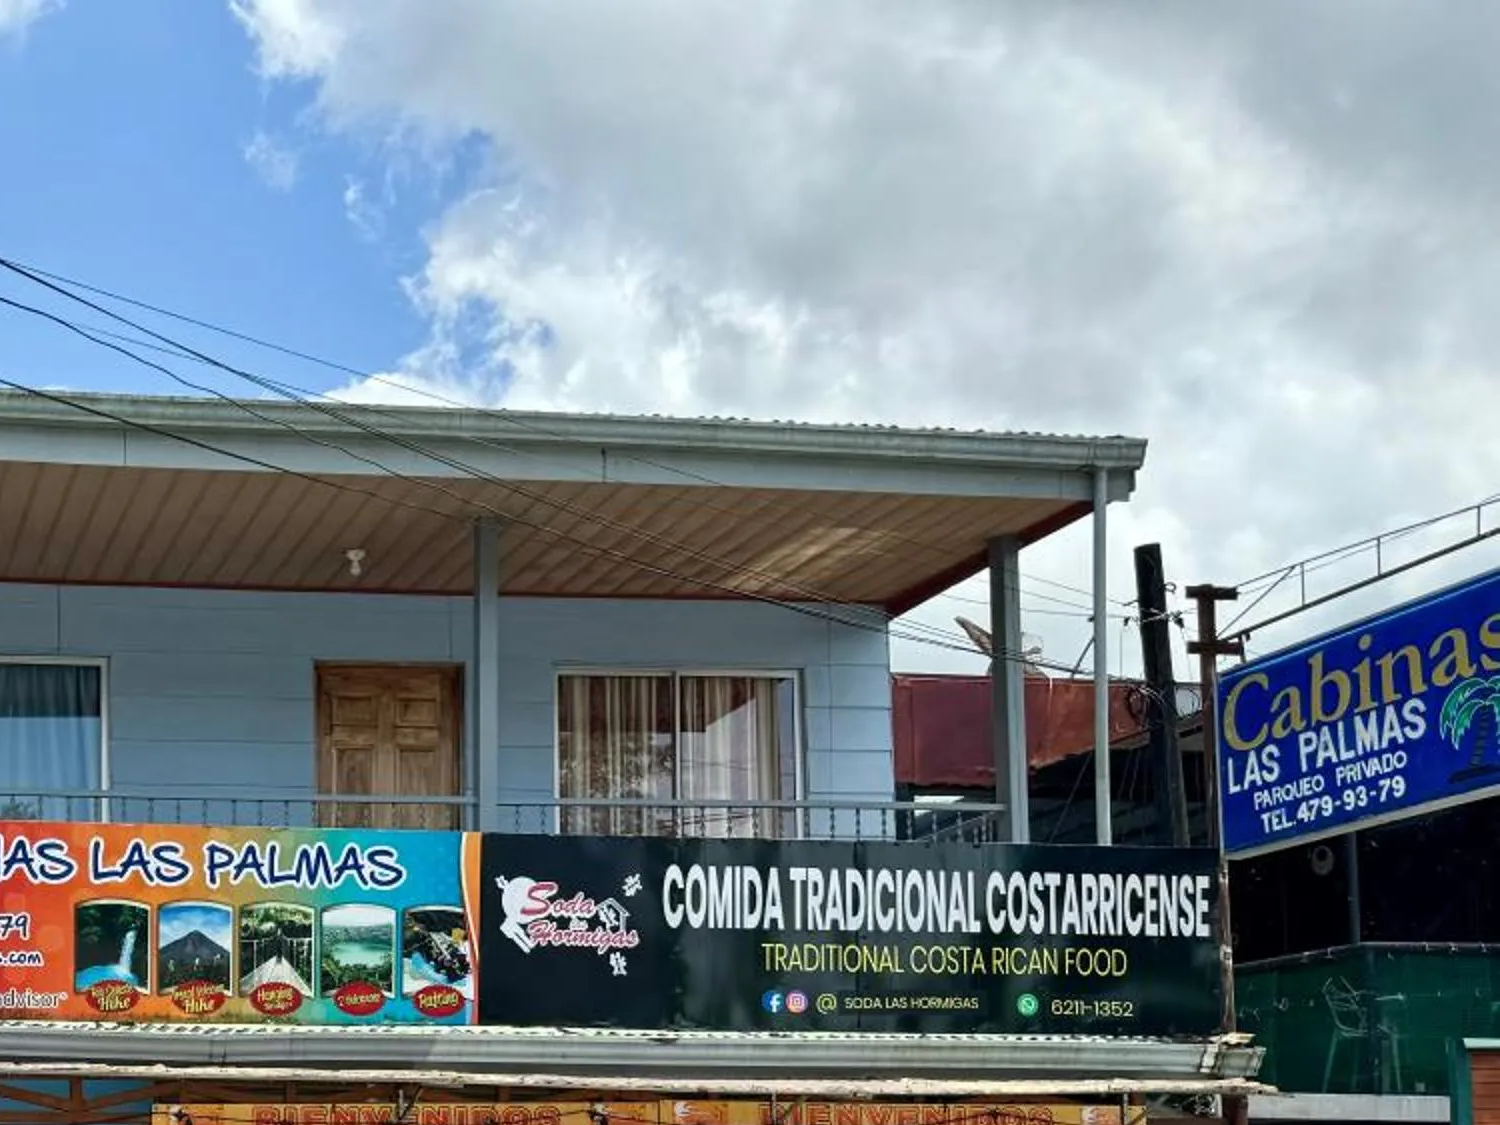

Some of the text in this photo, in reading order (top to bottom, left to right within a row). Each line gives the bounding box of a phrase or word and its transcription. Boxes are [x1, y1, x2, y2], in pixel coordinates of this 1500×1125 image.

[1228, 698, 1427, 795] LAS PALMAS
[1253, 750, 1407, 811] PARQUEO PRIVADO
[87, 838, 193, 887] LAS
[203, 841, 407, 891] PALMAS
[520, 881, 597, 917] Soda
[662, 863, 1211, 937] COMIDA TRADICIONAL COSTARRICENSE
[527, 920, 640, 955] Hormigas
[761, 942, 1128, 977] TRADITIONAL COSTA RICAN FOOD
[844, 995, 882, 1010] SODA
[885, 996, 908, 1010] LAS
[910, 996, 979, 1010] HORMIGAS
[1051, 999, 1134, 1018] 6211-1352
